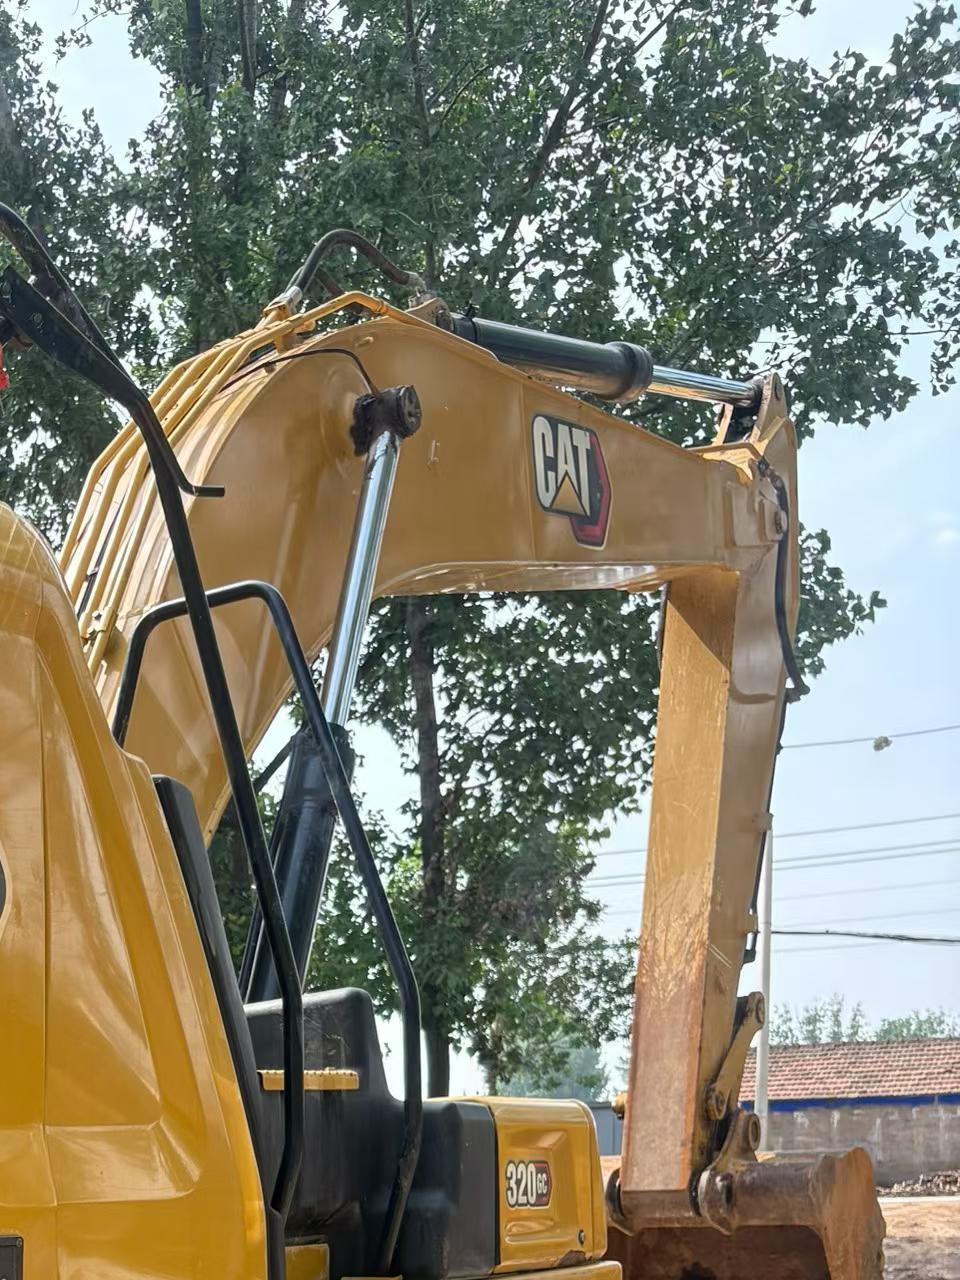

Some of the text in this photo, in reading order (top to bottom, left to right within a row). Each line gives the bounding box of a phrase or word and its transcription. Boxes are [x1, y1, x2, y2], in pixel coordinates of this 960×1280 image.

[533, 416, 591, 516] CAT
[506, 1162, 548, 1206] 320 GC
